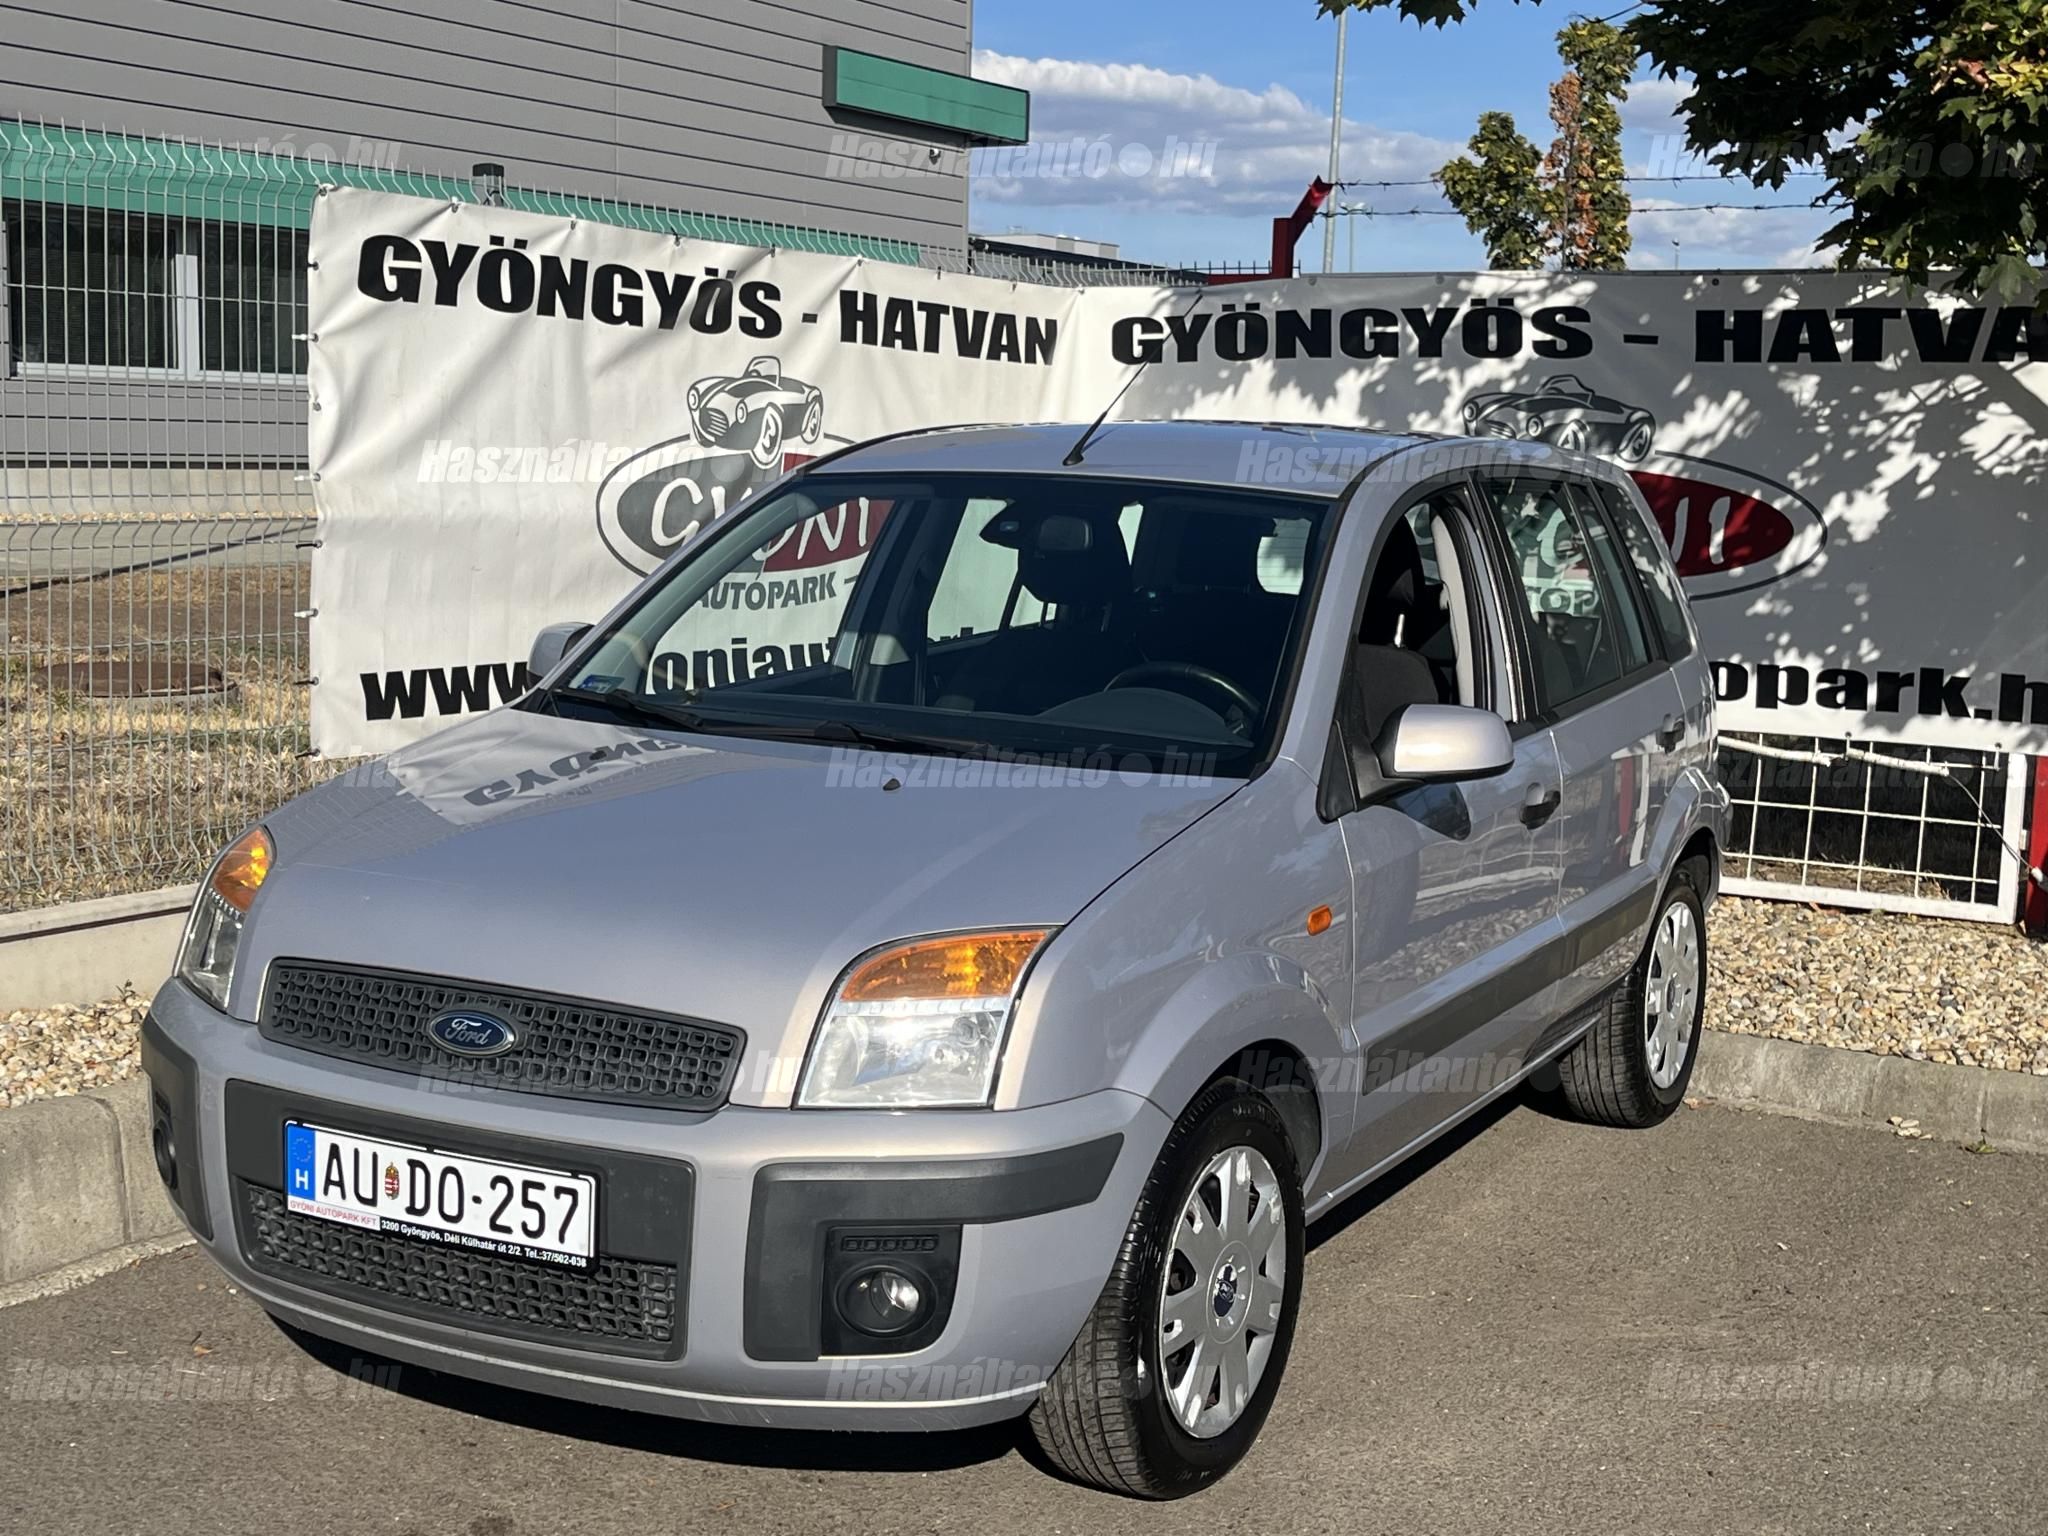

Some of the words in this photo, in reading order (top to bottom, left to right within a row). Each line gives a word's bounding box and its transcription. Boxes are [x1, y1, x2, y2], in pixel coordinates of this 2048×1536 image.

[357, 234, 782, 339] GYÖNGYÖS
[840, 289, 1058, 366] HATVAN
[1111, 297, 1594, 366] GYÖNGYÖS
[445, 1018, 492, 1045] Ford
[295, 1168, 309, 1191] H
[405, 1158, 580, 1245] DO-257
[381, 1219, 400, 1232] 3200
